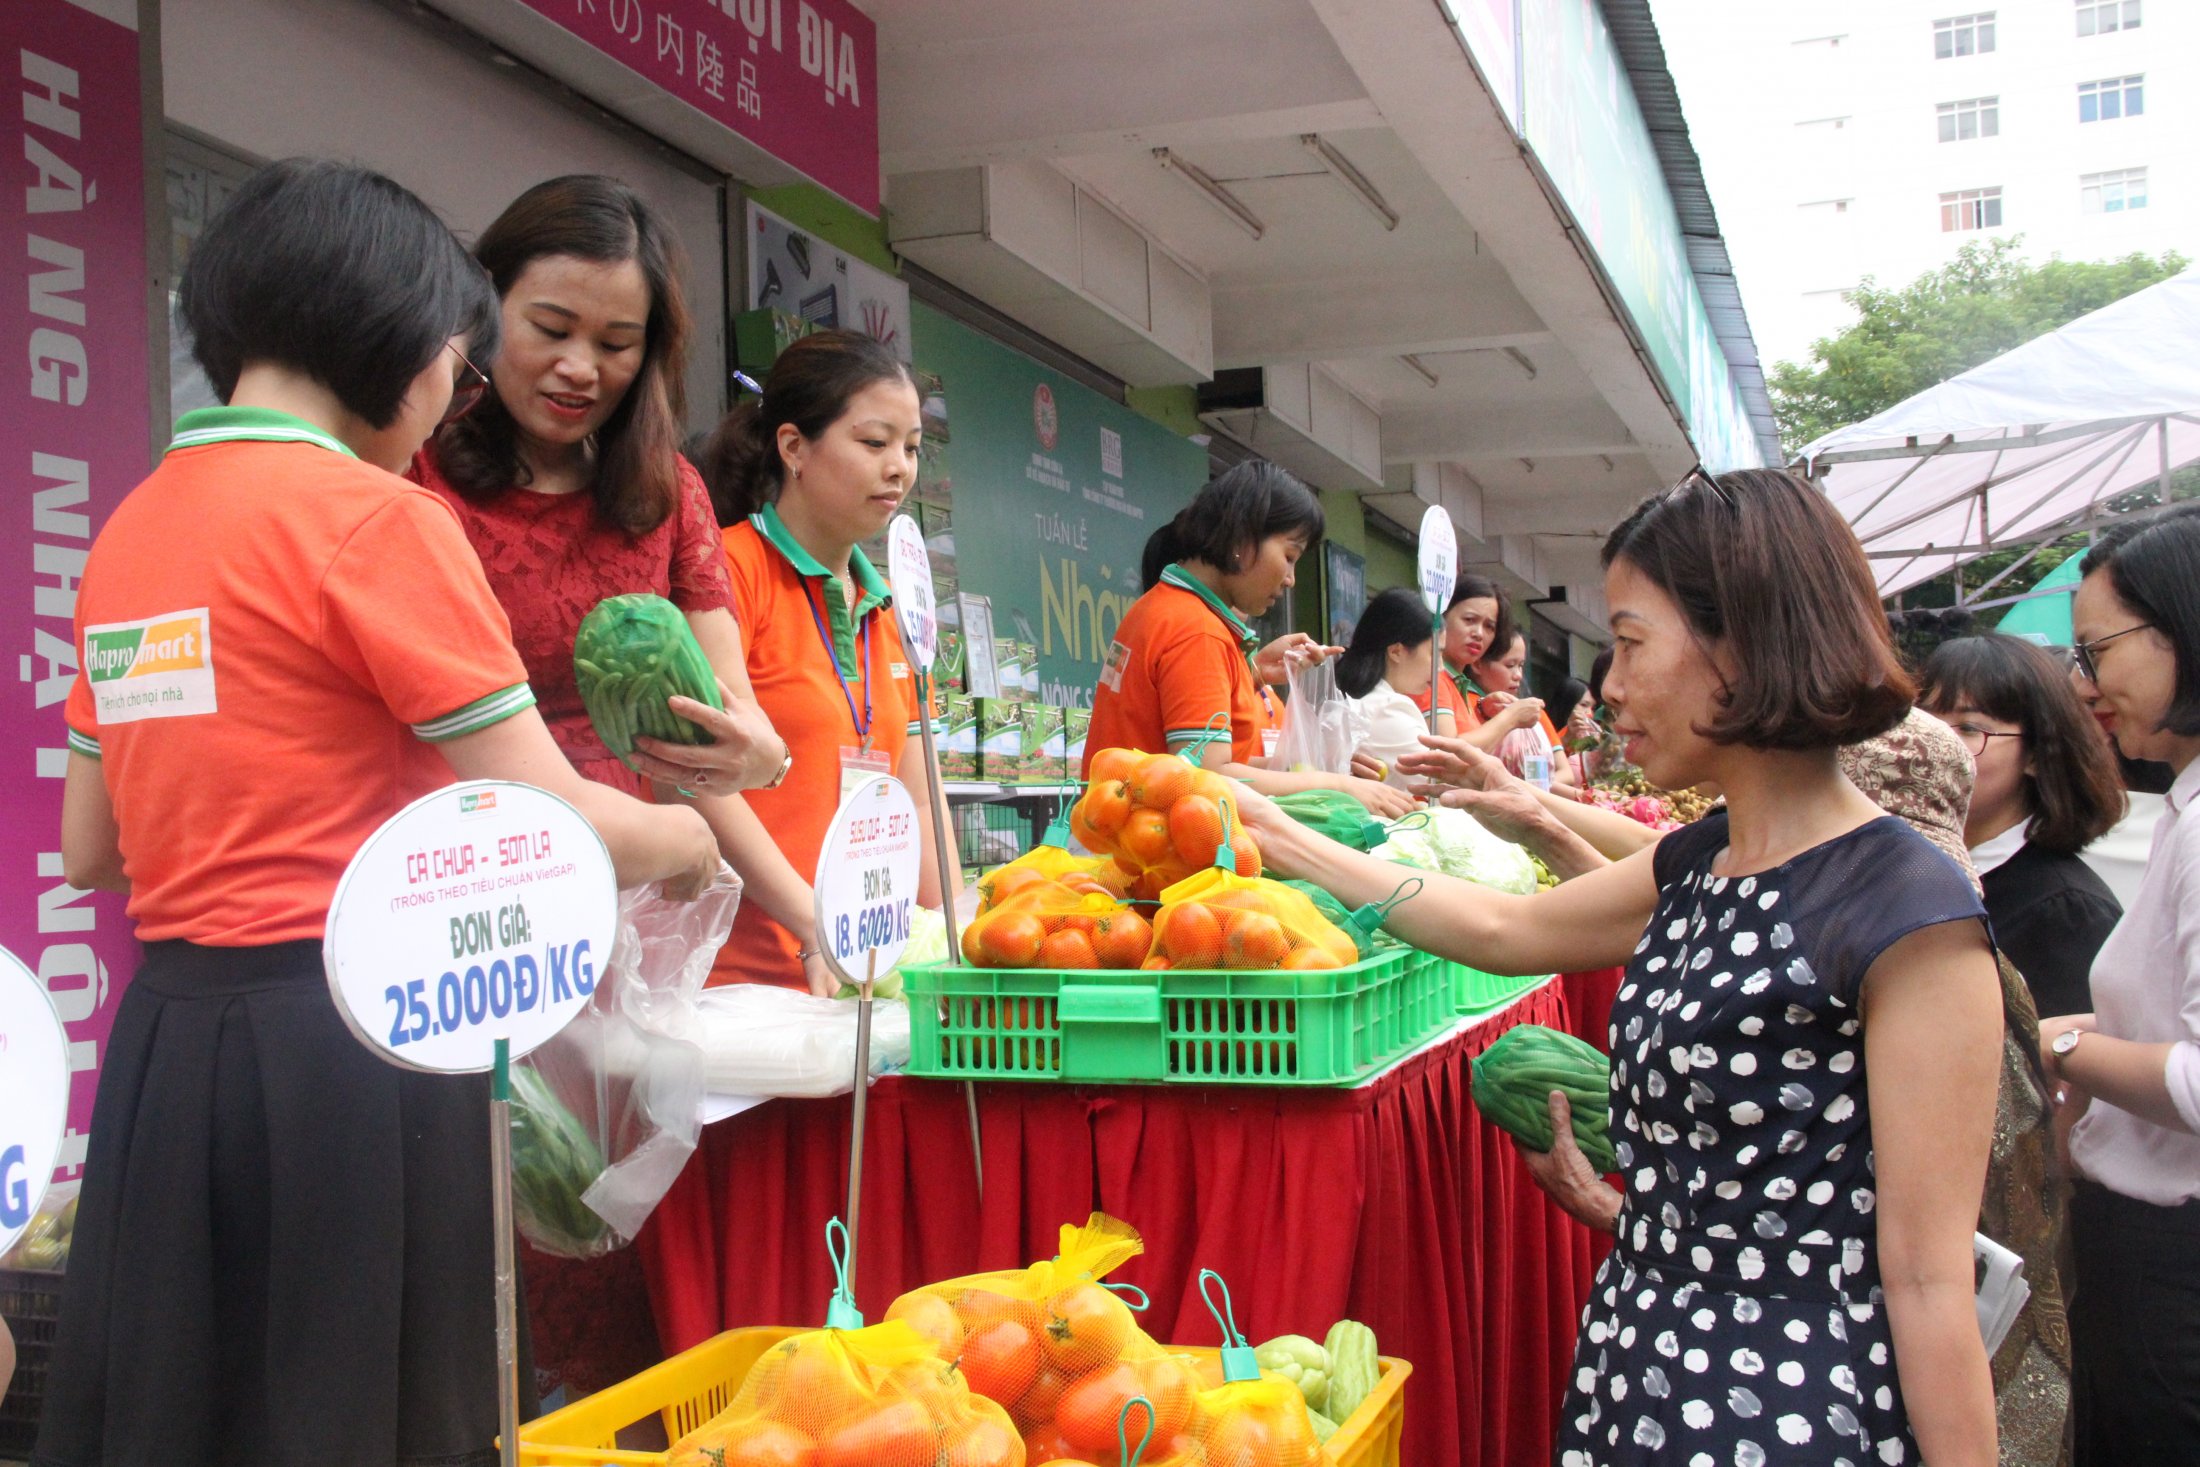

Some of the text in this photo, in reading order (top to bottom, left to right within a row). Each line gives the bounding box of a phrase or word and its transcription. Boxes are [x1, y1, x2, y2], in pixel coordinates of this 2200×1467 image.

[577, 0, 761, 120] の内陸品
[796, 2, 861, 108] ĐỊA
[20, 47, 97, 407] HÀNG
[162, 686, 184, 702] nhà
[433, 844, 475, 878] CHUA
[532, 830, 551, 860] LA
[437, 884, 468, 903] THEO
[535, 863, 577, 882] VietGAP)
[449, 910, 493, 959] ĐƠN
[385, 939, 595, 1048] 25.000Đ/KG
